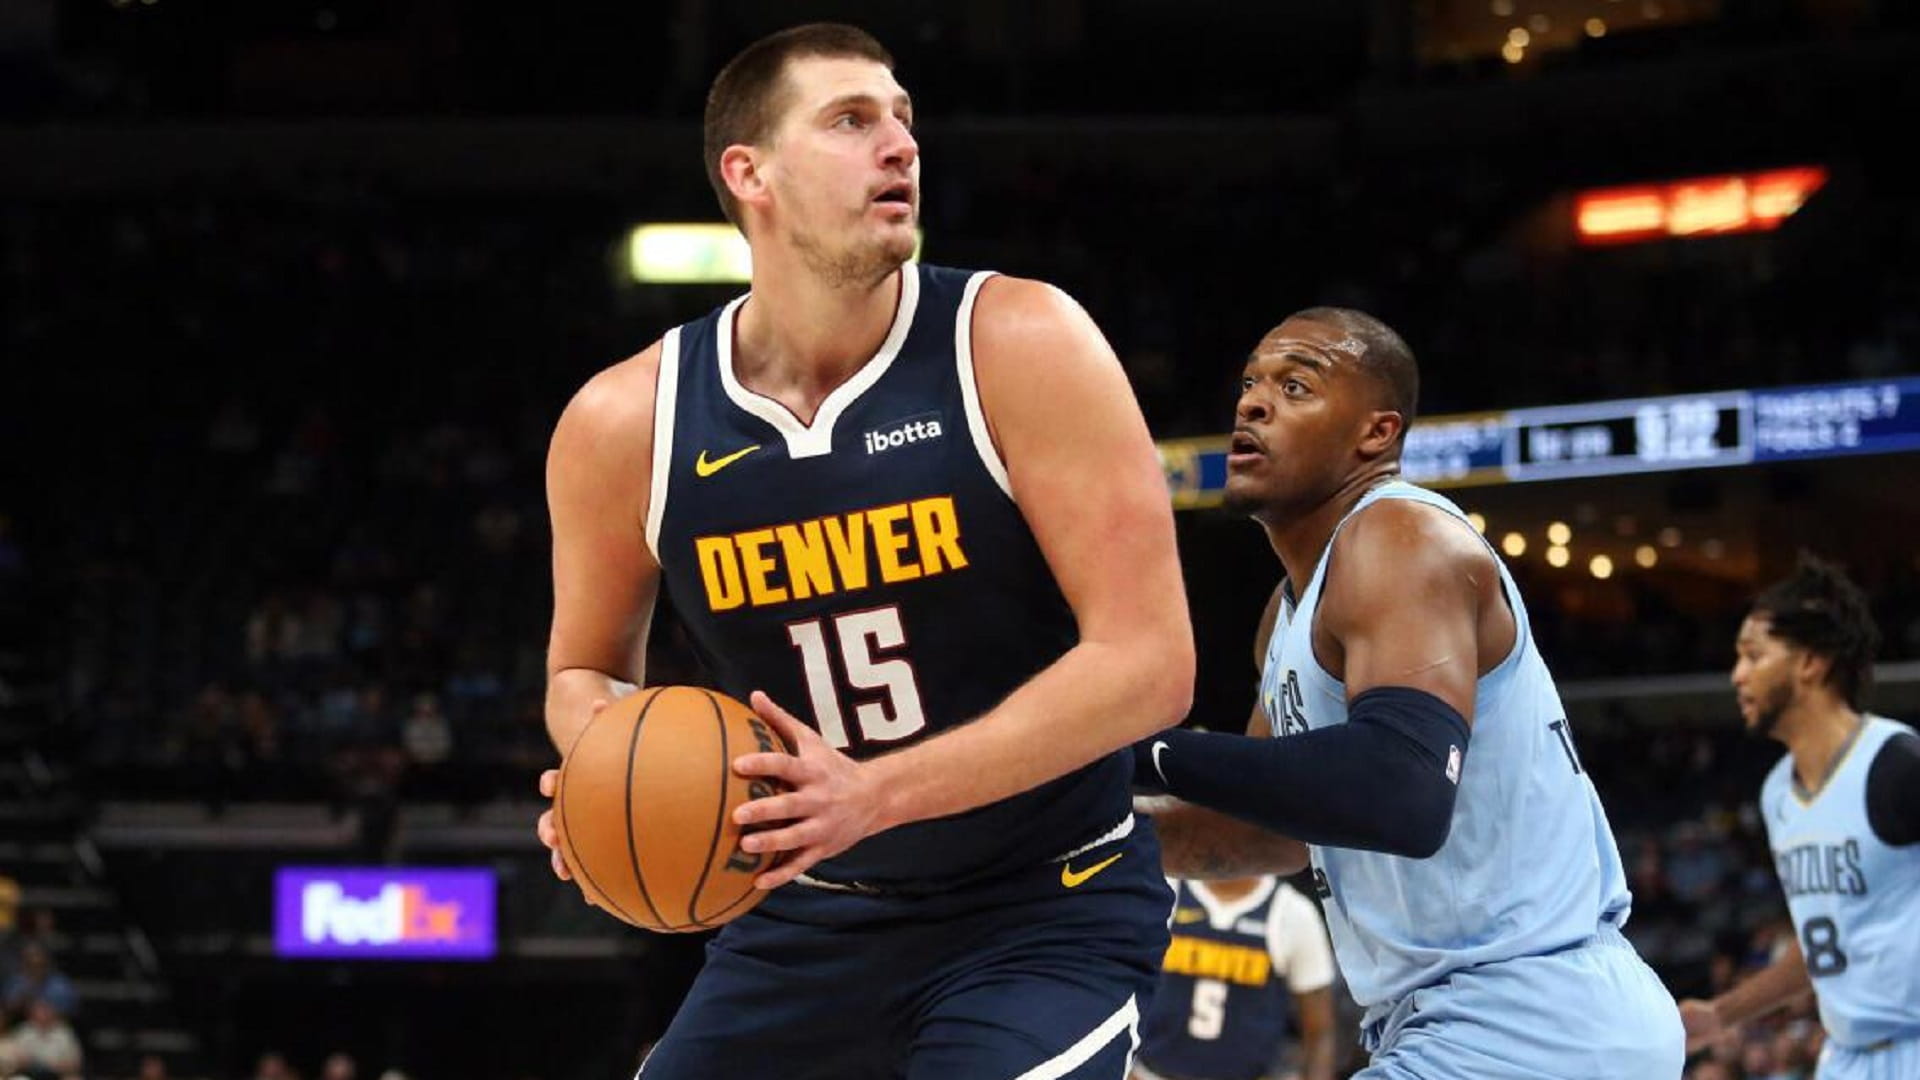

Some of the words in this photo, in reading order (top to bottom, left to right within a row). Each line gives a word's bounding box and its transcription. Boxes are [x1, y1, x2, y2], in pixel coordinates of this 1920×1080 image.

[864, 420, 942, 455] ibotta
[694, 494, 970, 614] DENVER
[786, 604, 927, 750] 15
[303, 880, 464, 944] FedEx
[1803, 915, 1848, 979] 8
[1187, 977, 1229, 1041] 5
